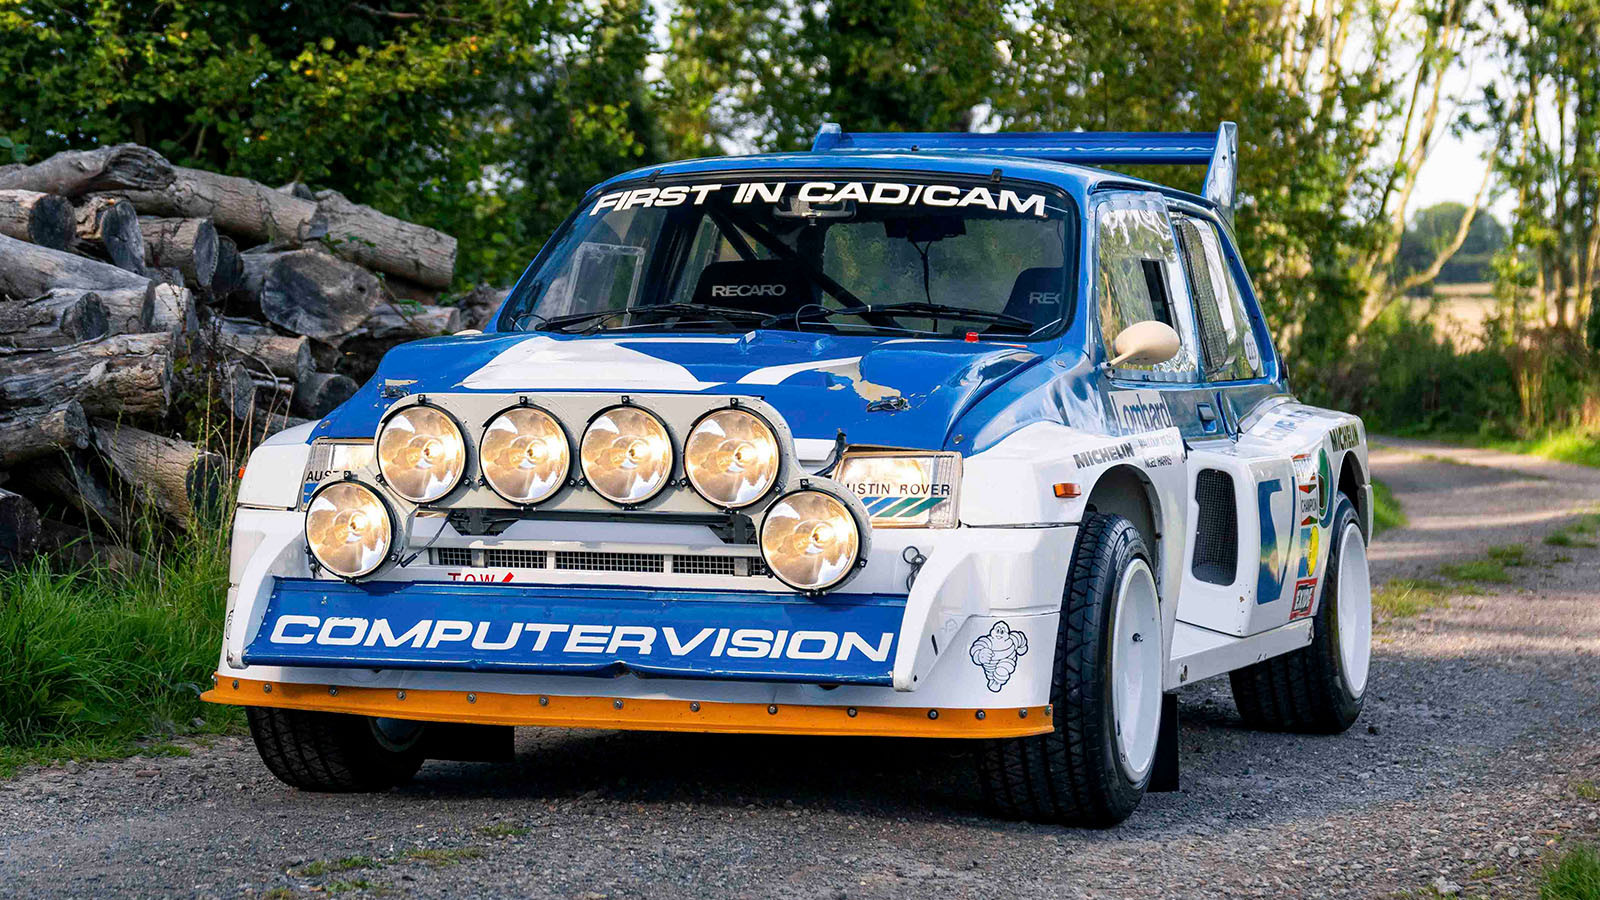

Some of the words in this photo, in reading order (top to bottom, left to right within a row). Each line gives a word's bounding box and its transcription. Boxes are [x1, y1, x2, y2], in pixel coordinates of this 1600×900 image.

[590, 184, 722, 216] FIRST
[733, 183, 786, 203] IN
[797, 182, 1046, 217] CAD/CAM
[711, 284, 787, 297] RECARO
[1110, 393, 1174, 435] Lombard
[1329, 422, 1360, 453] MICHELIN
[1073, 442, 1135, 469] MICHELIN
[900, 483, 950, 496] ROVER
[269, 614, 895, 662] COMPUTERVISION
